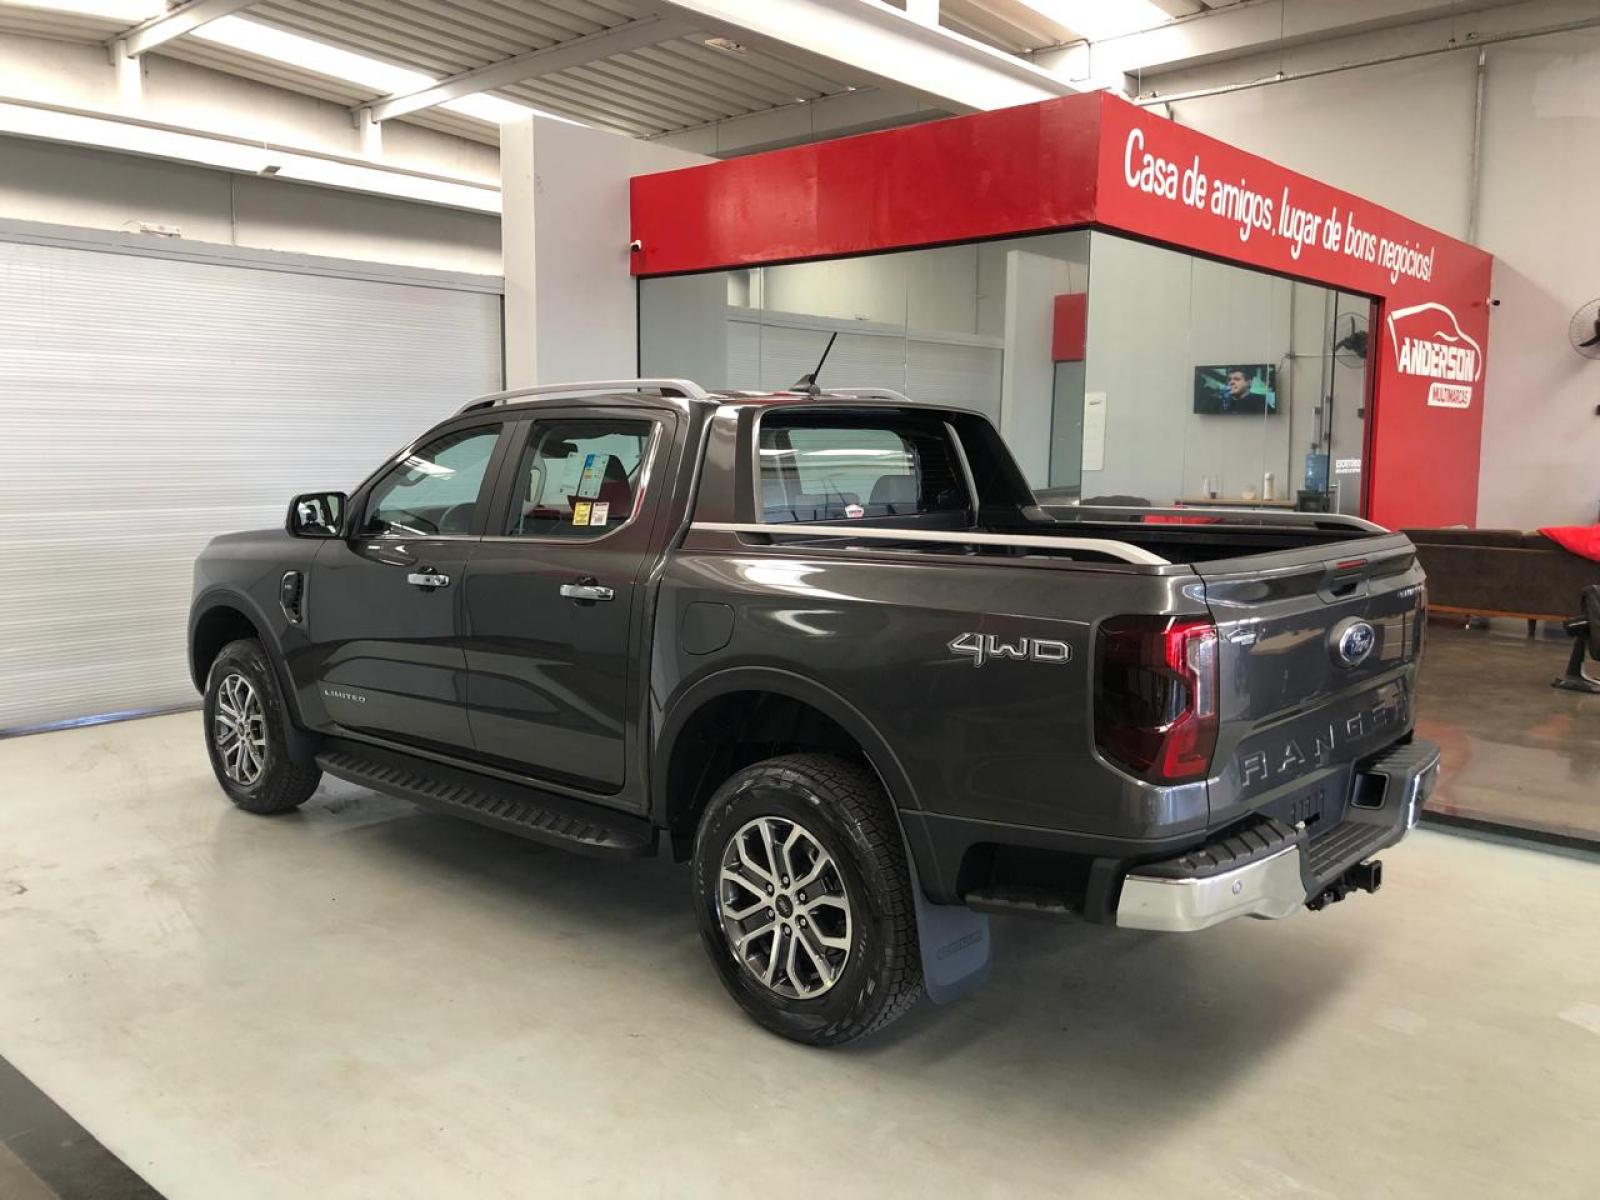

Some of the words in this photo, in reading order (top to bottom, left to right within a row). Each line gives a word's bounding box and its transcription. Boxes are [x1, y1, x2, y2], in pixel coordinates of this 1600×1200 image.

[1124, 127, 1179, 200] Casa
[1182, 155, 1208, 209] de
[1278, 186, 1322, 261] lugar
[1322, 206, 1342, 252] de
[1344, 211, 1377, 262] bons
[1378, 237, 1435, 285] negócios!
[1398, 336, 1475, 382] ANDERSON
[1431, 386, 1469, 404] MULTIMARCAS
[947, 631, 1073, 668] 4WD
[324, 689, 366, 703] LIMITED
